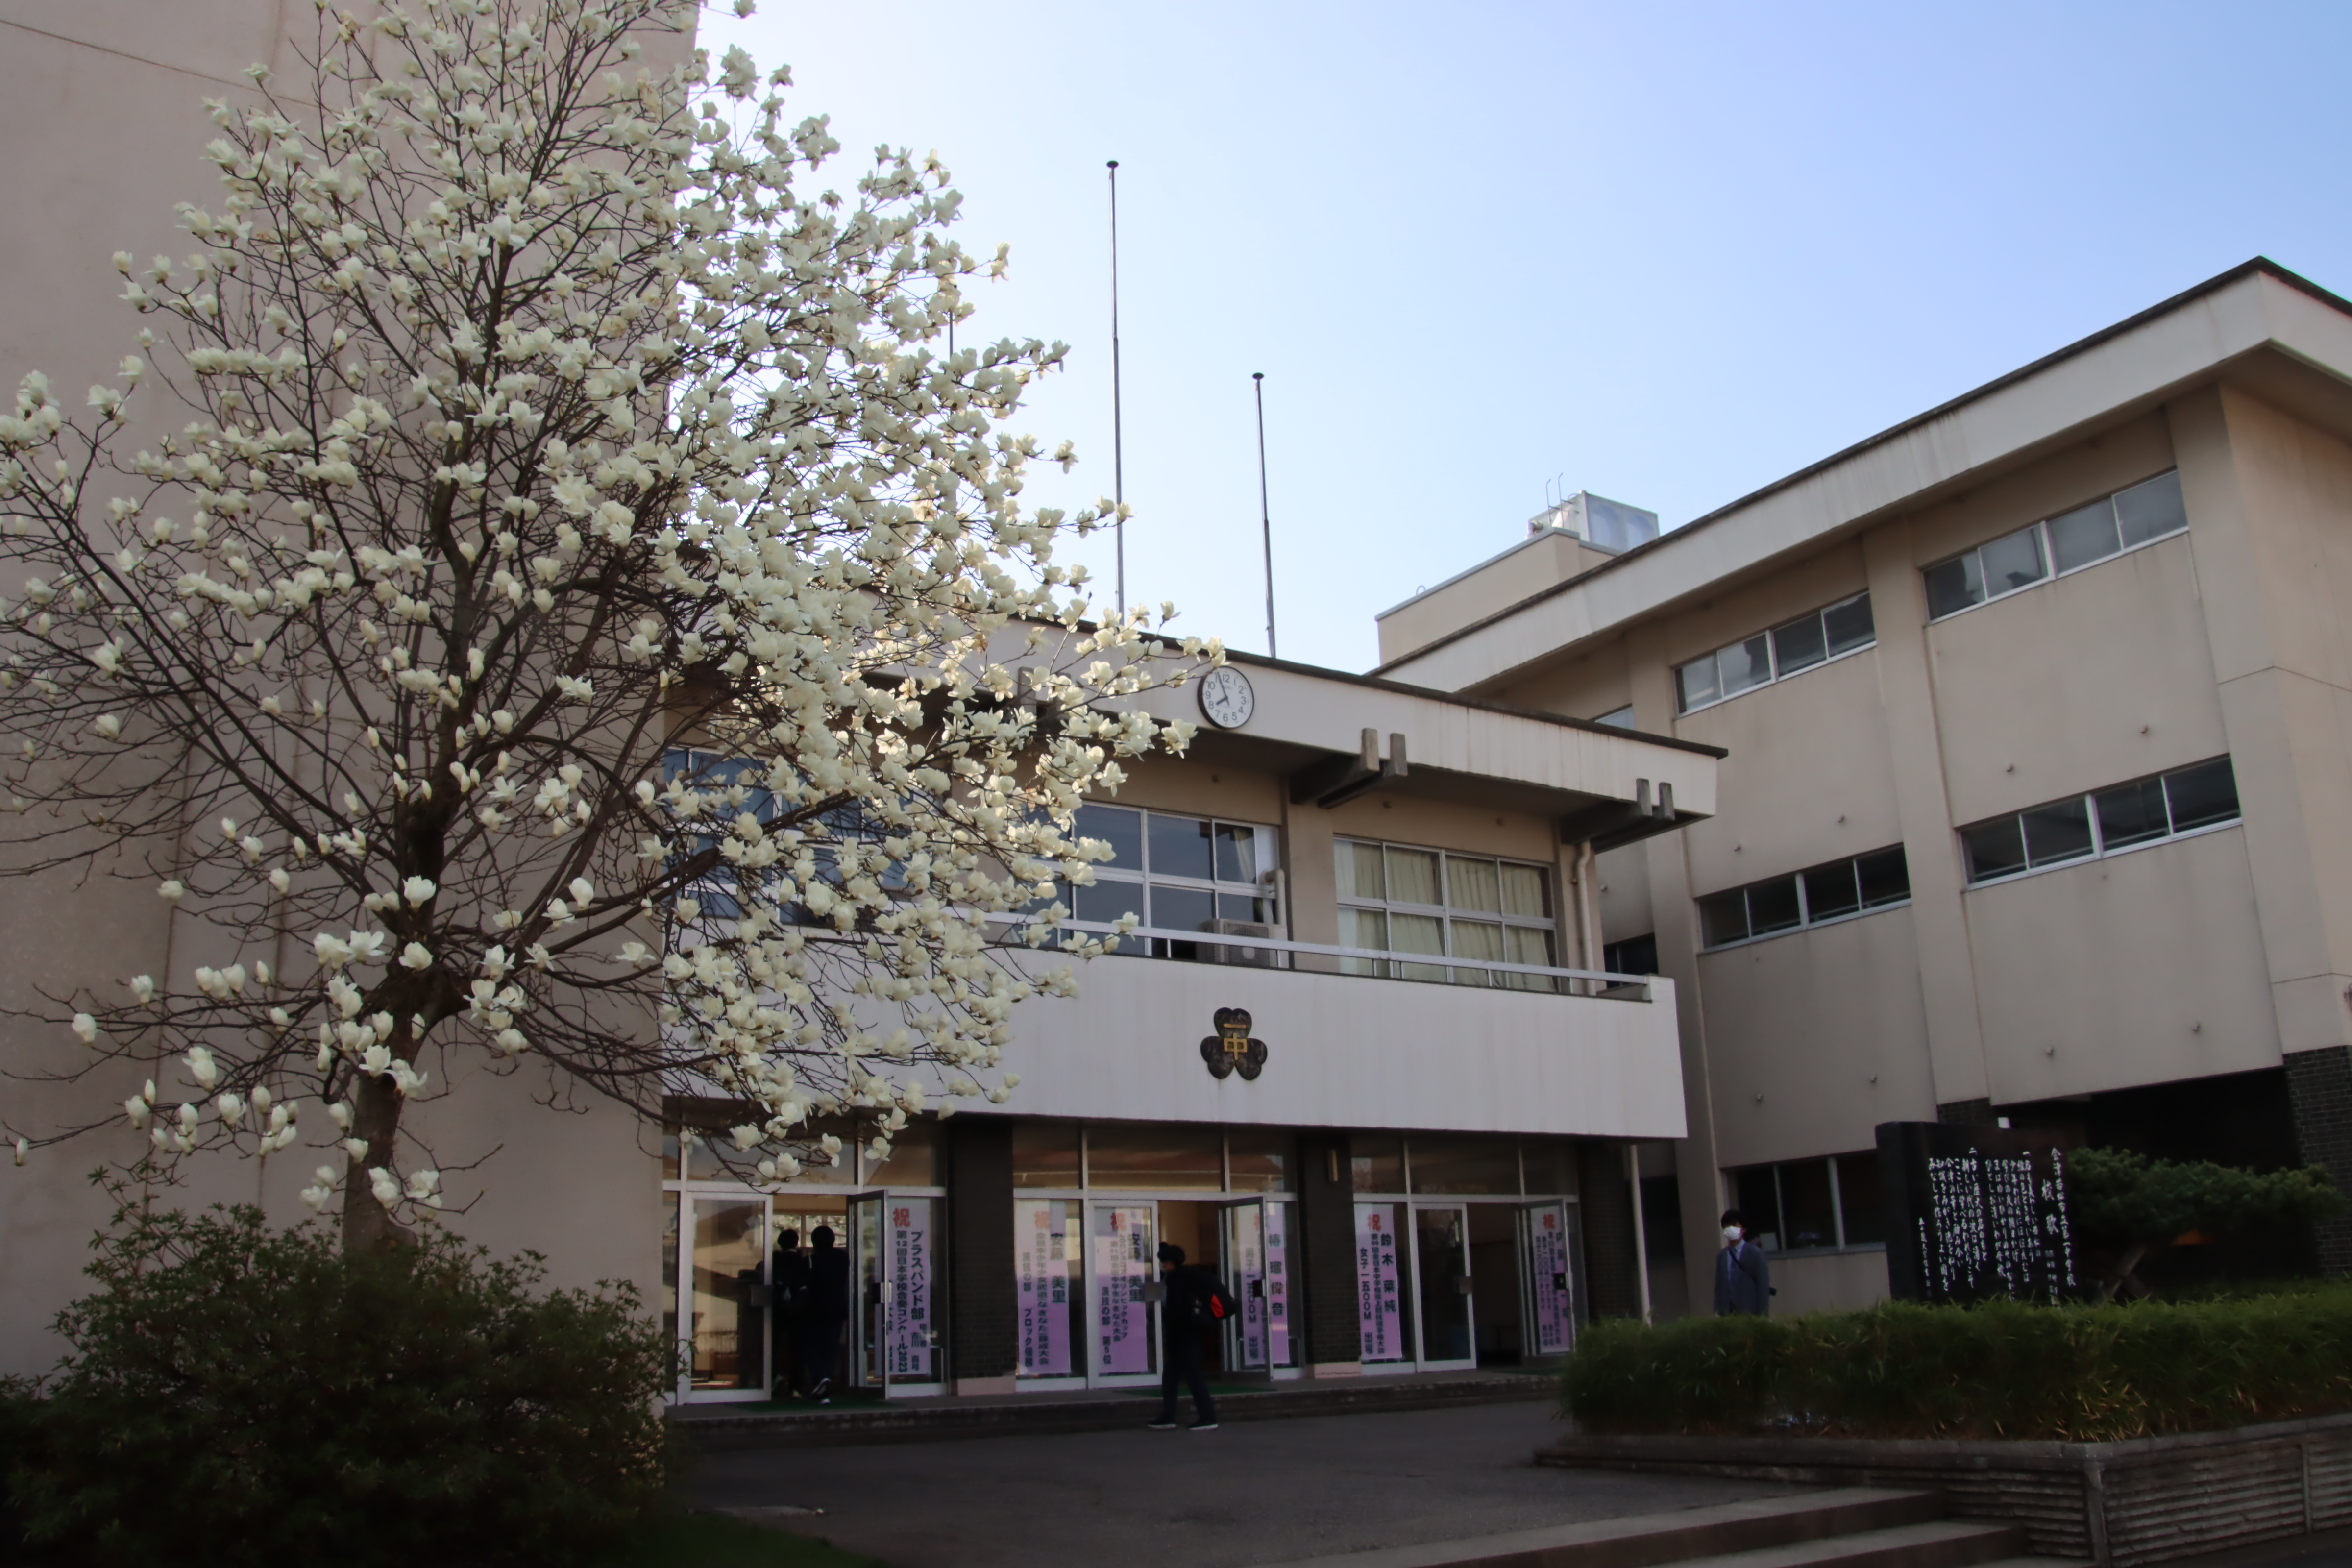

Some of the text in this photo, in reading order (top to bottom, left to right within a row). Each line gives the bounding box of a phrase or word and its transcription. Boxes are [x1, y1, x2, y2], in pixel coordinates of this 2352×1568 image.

[1208, 682, 1215, 690] 10
[1223, 674, 1230, 683] 12
[1205, 691, 1211, 699] 9
[1241, 696, 1246, 705] 3
[1208, 701, 1214, 709] 8
[1232, 712, 1237, 720] 5
[893, 1207, 911, 1227] 祝
[1034, 1210, 1050, 1229] 祝
[1110, 1212, 1126, 1230] 祝
[1367, 1214, 1381, 1231] 祝
[1544, 1214, 1555, 1229] 祝
[911, 1230, 924, 1320] ブラスバンド部
[1102, 1336, 1111, 1364] 第5位
